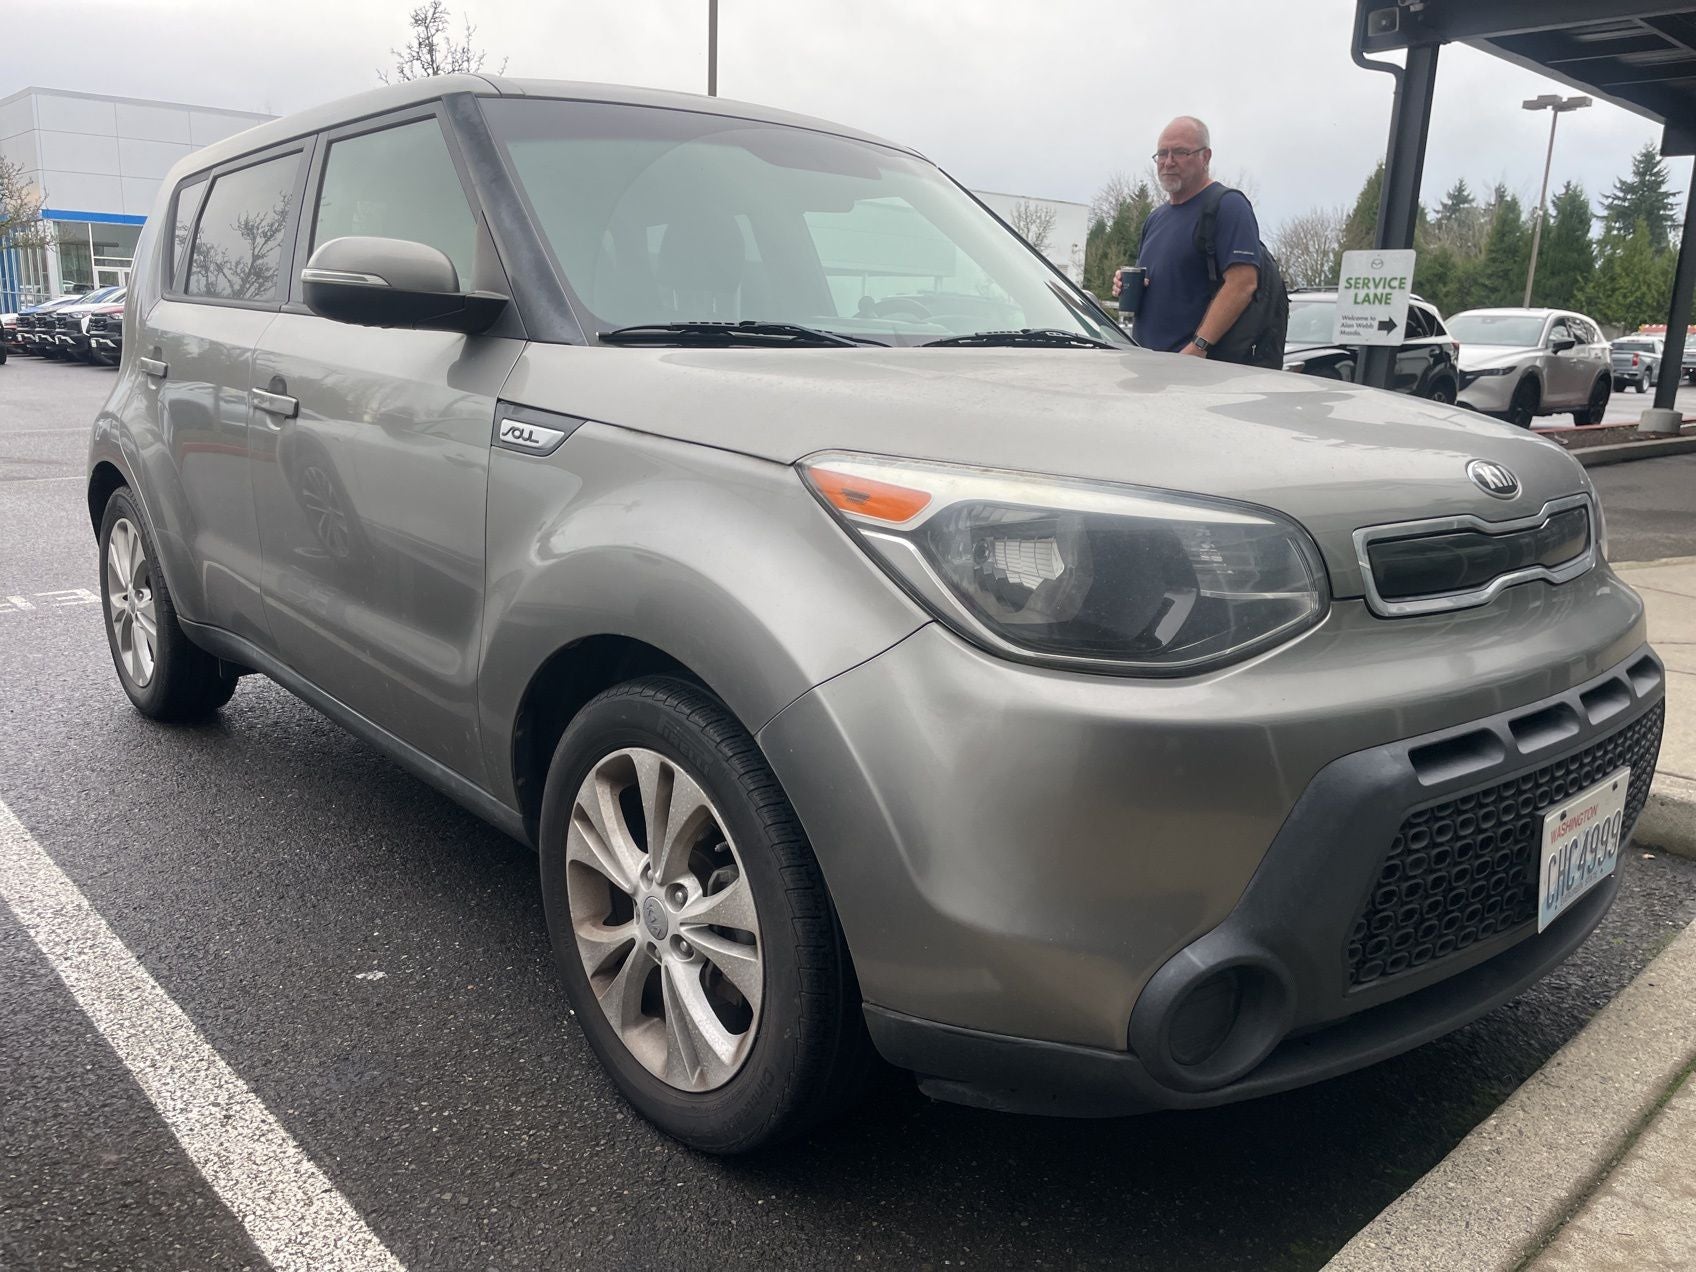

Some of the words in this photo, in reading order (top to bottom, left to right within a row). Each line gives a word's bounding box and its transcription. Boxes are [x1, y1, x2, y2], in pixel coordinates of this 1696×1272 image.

[1344, 277, 1407, 290] SERVICE
[1353, 292, 1393, 305] LANE
[1550, 804, 1599, 844] WASHINGTON
[1546, 808, 1622, 910] CHC4999
